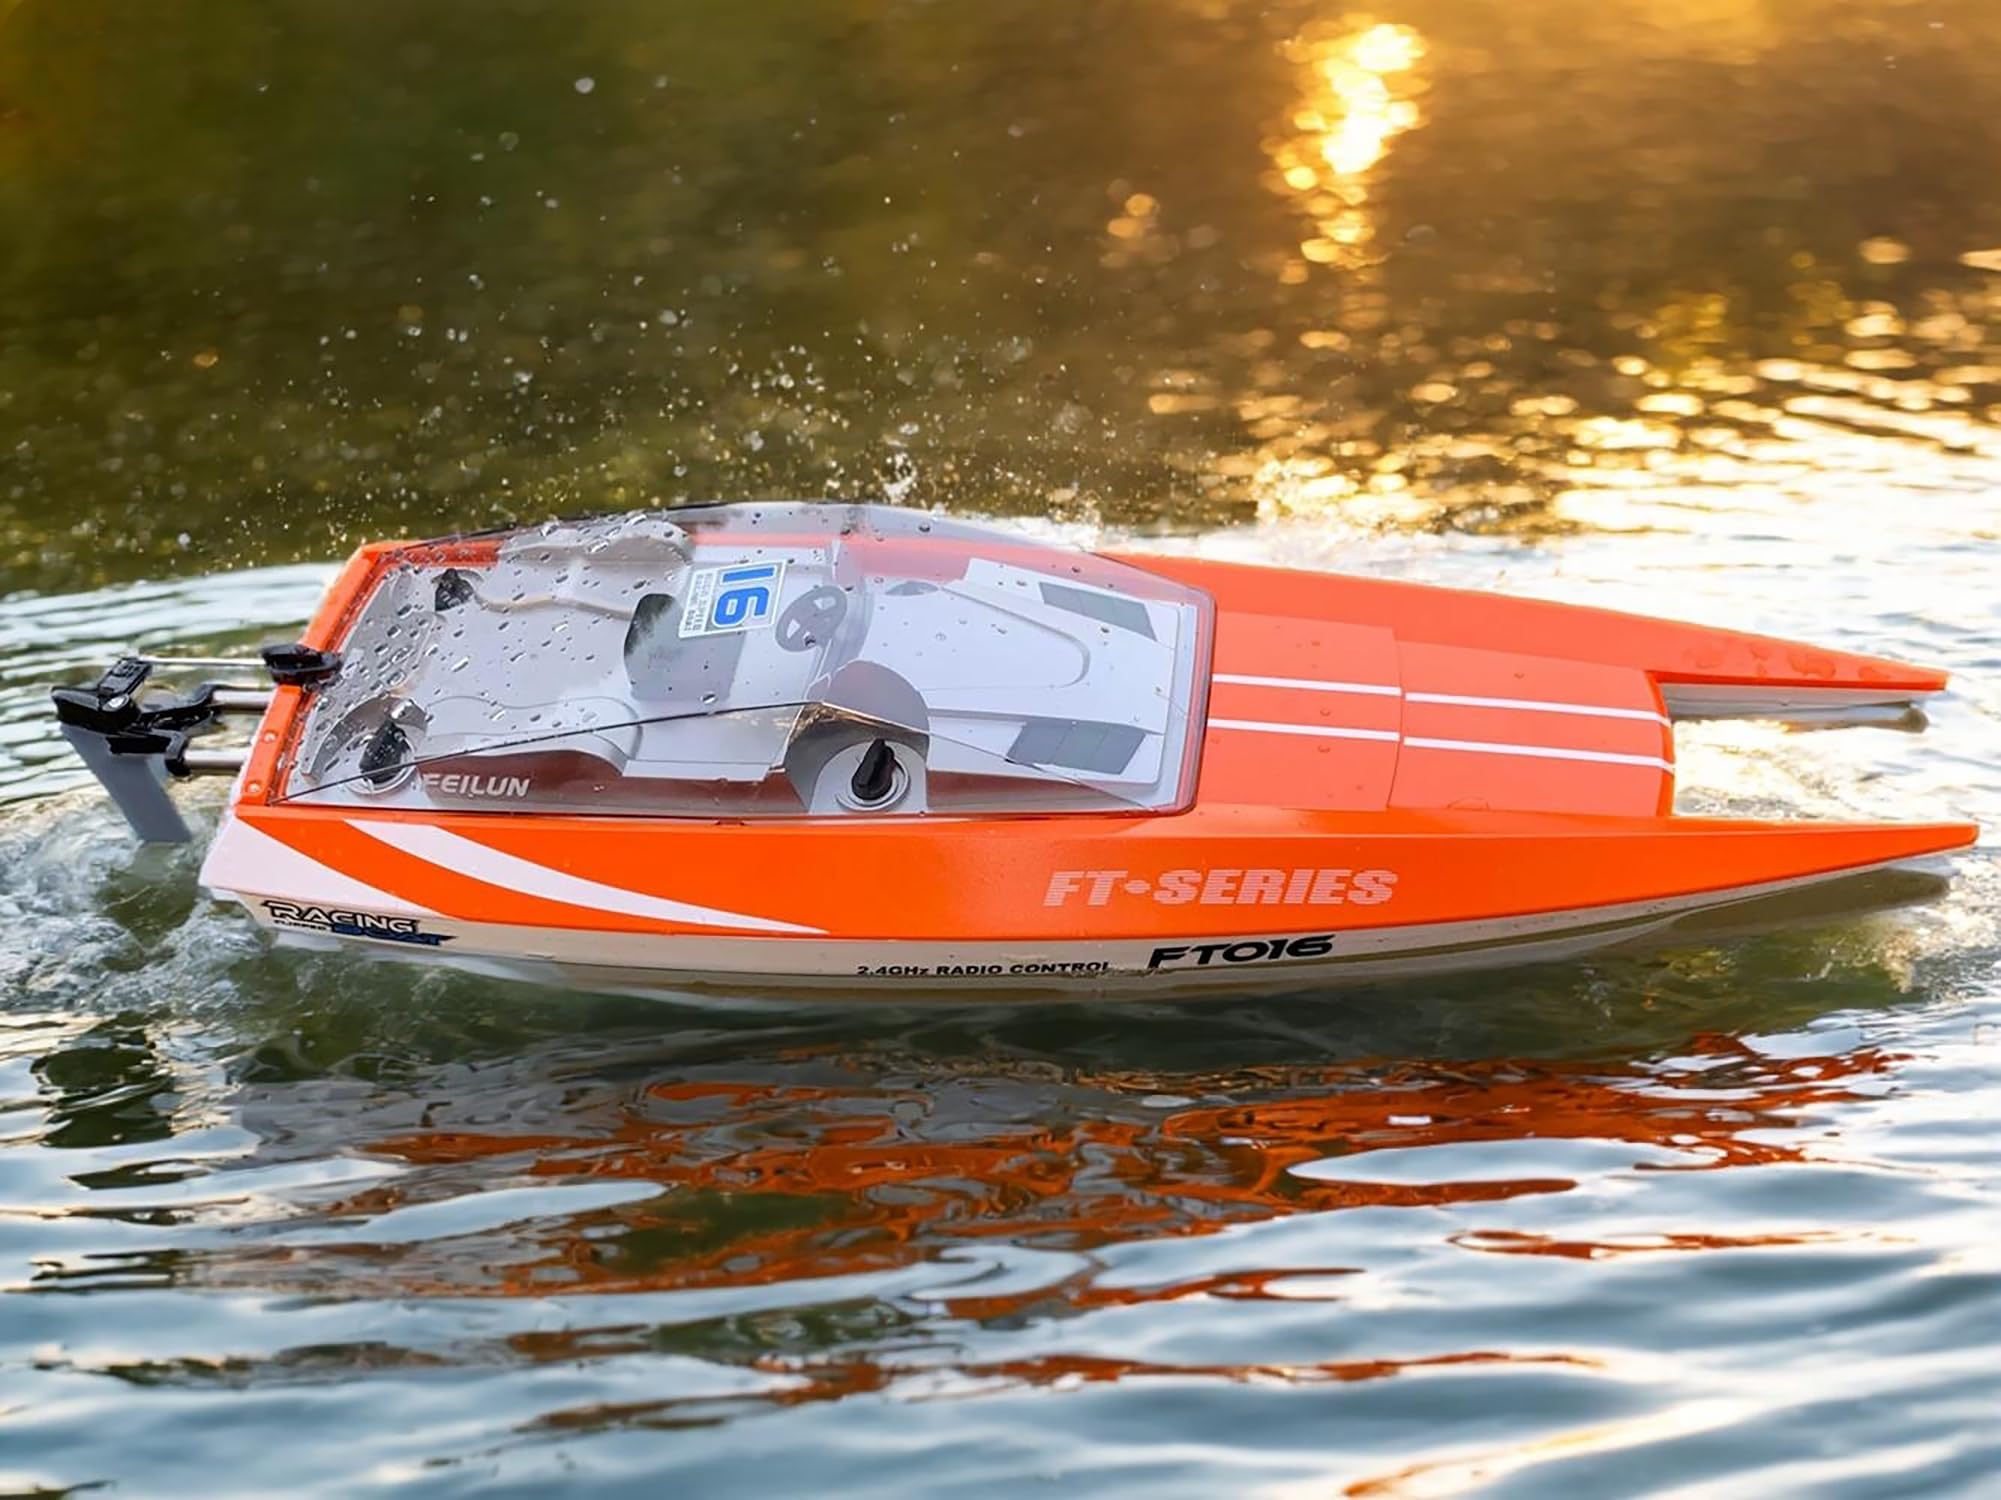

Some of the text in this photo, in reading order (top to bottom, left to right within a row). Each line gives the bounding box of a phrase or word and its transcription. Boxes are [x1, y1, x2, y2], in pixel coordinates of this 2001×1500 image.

[713, 566, 775, 626] 16
[422, 773, 531, 798] FEILUN
[261, 899, 421, 934] RACING
[857, 965, 930, 976] 2.4GHz
[936, 964, 1003, 976] RADIO
